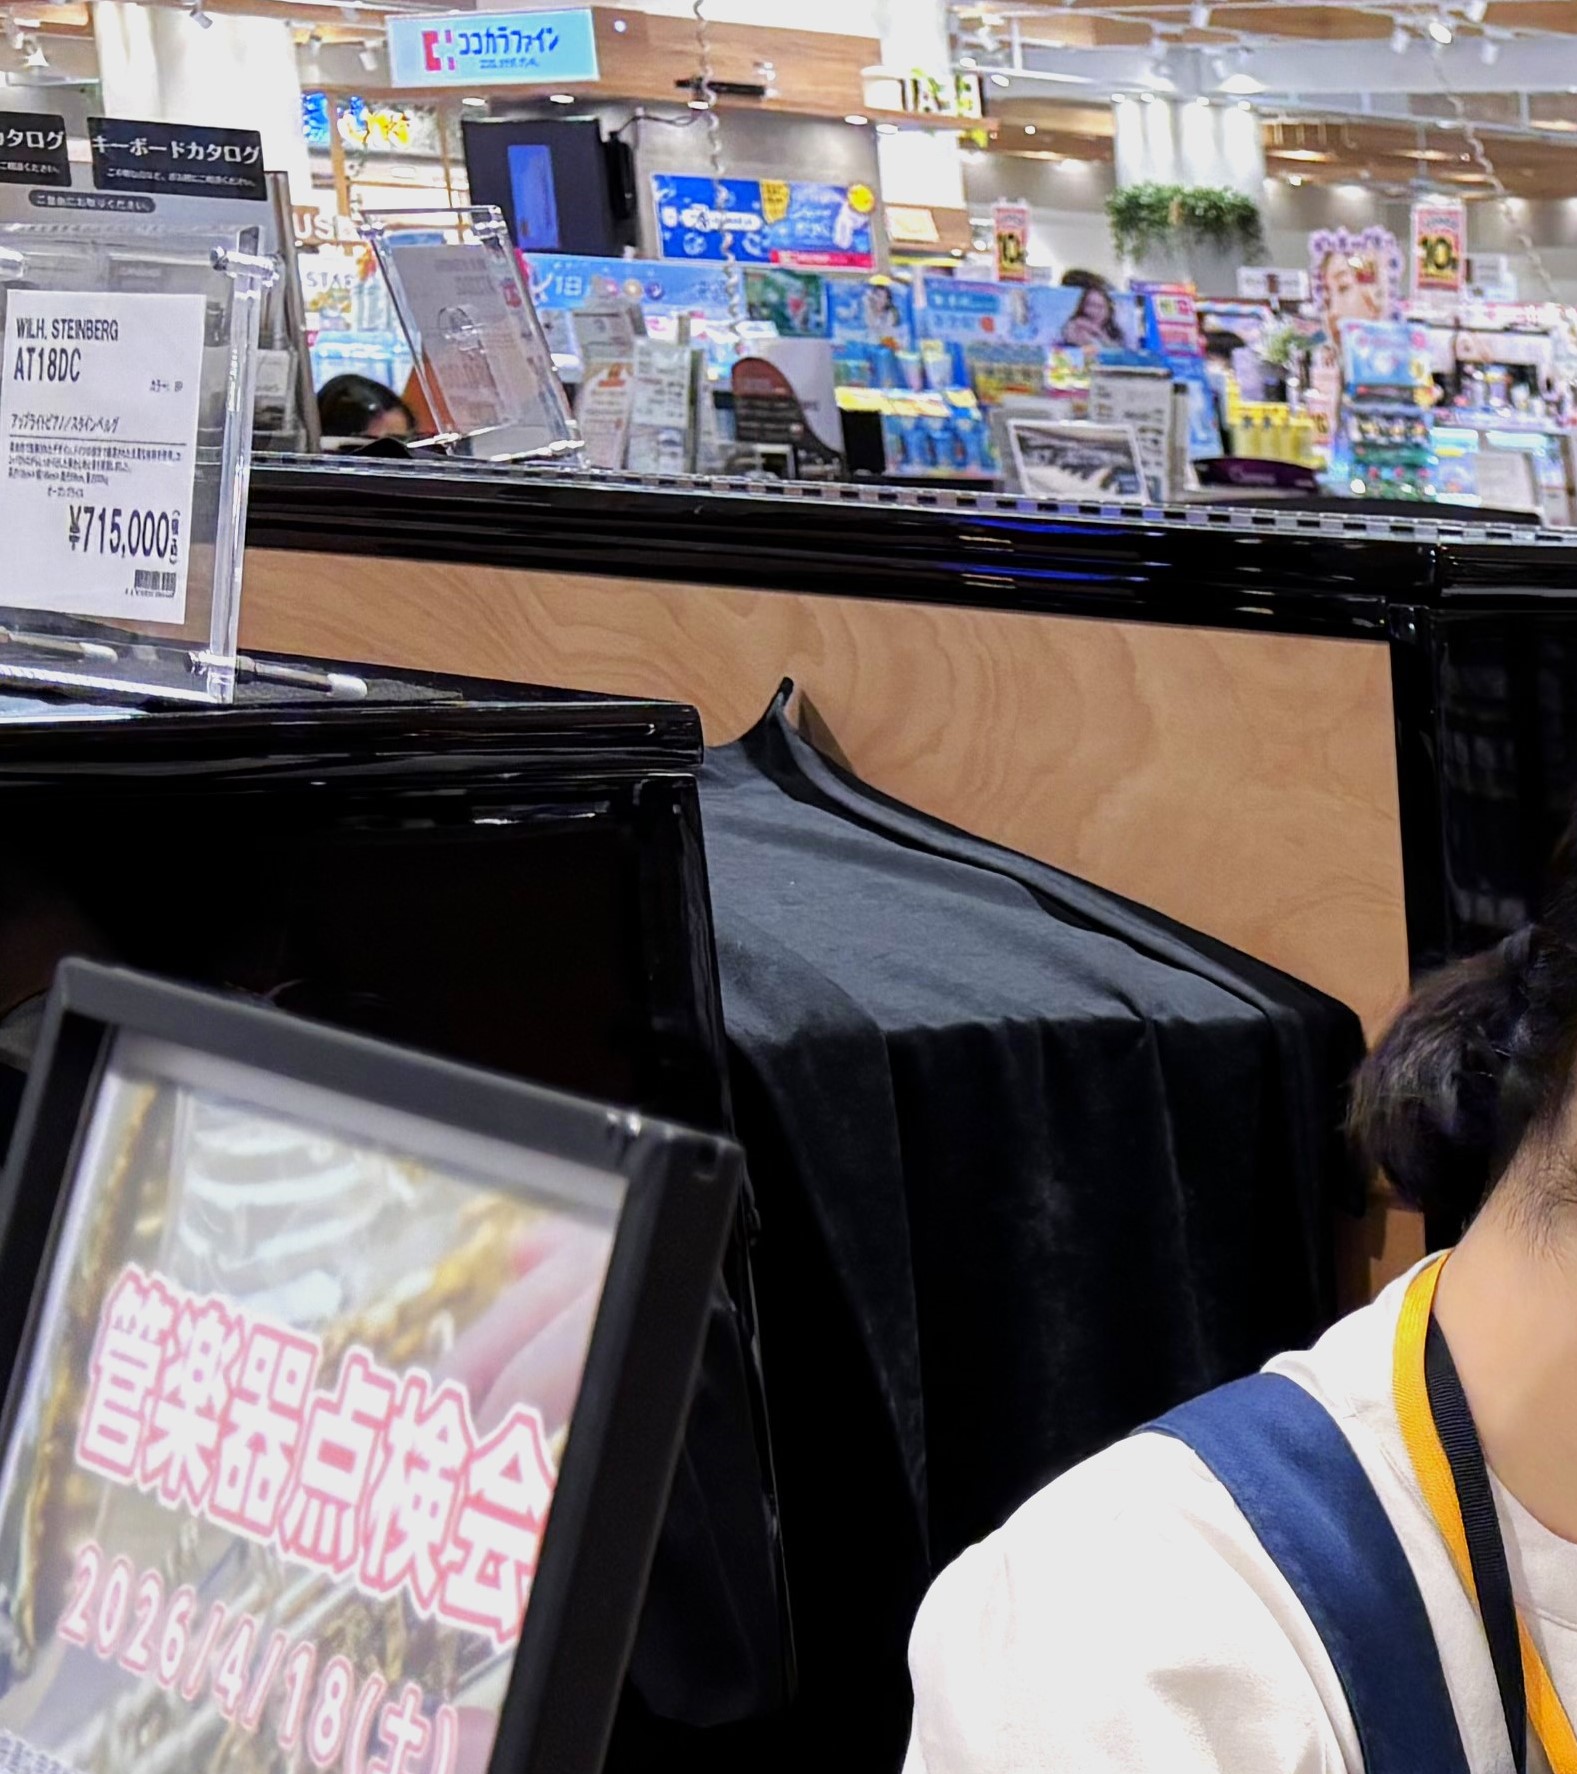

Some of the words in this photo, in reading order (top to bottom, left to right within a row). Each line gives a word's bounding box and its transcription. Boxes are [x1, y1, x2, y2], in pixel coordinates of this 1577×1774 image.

[458, 27, 559, 55] ココカラファイン
[92, 135, 260, 164] キーボードカタログ
[51, 318, 119, 342] STEINBERG
[14, 347, 82, 382] AT18DC
[69, 504, 170, 559] ¥715,000
[78, 1265, 556, 1650] 管楽器点検会
